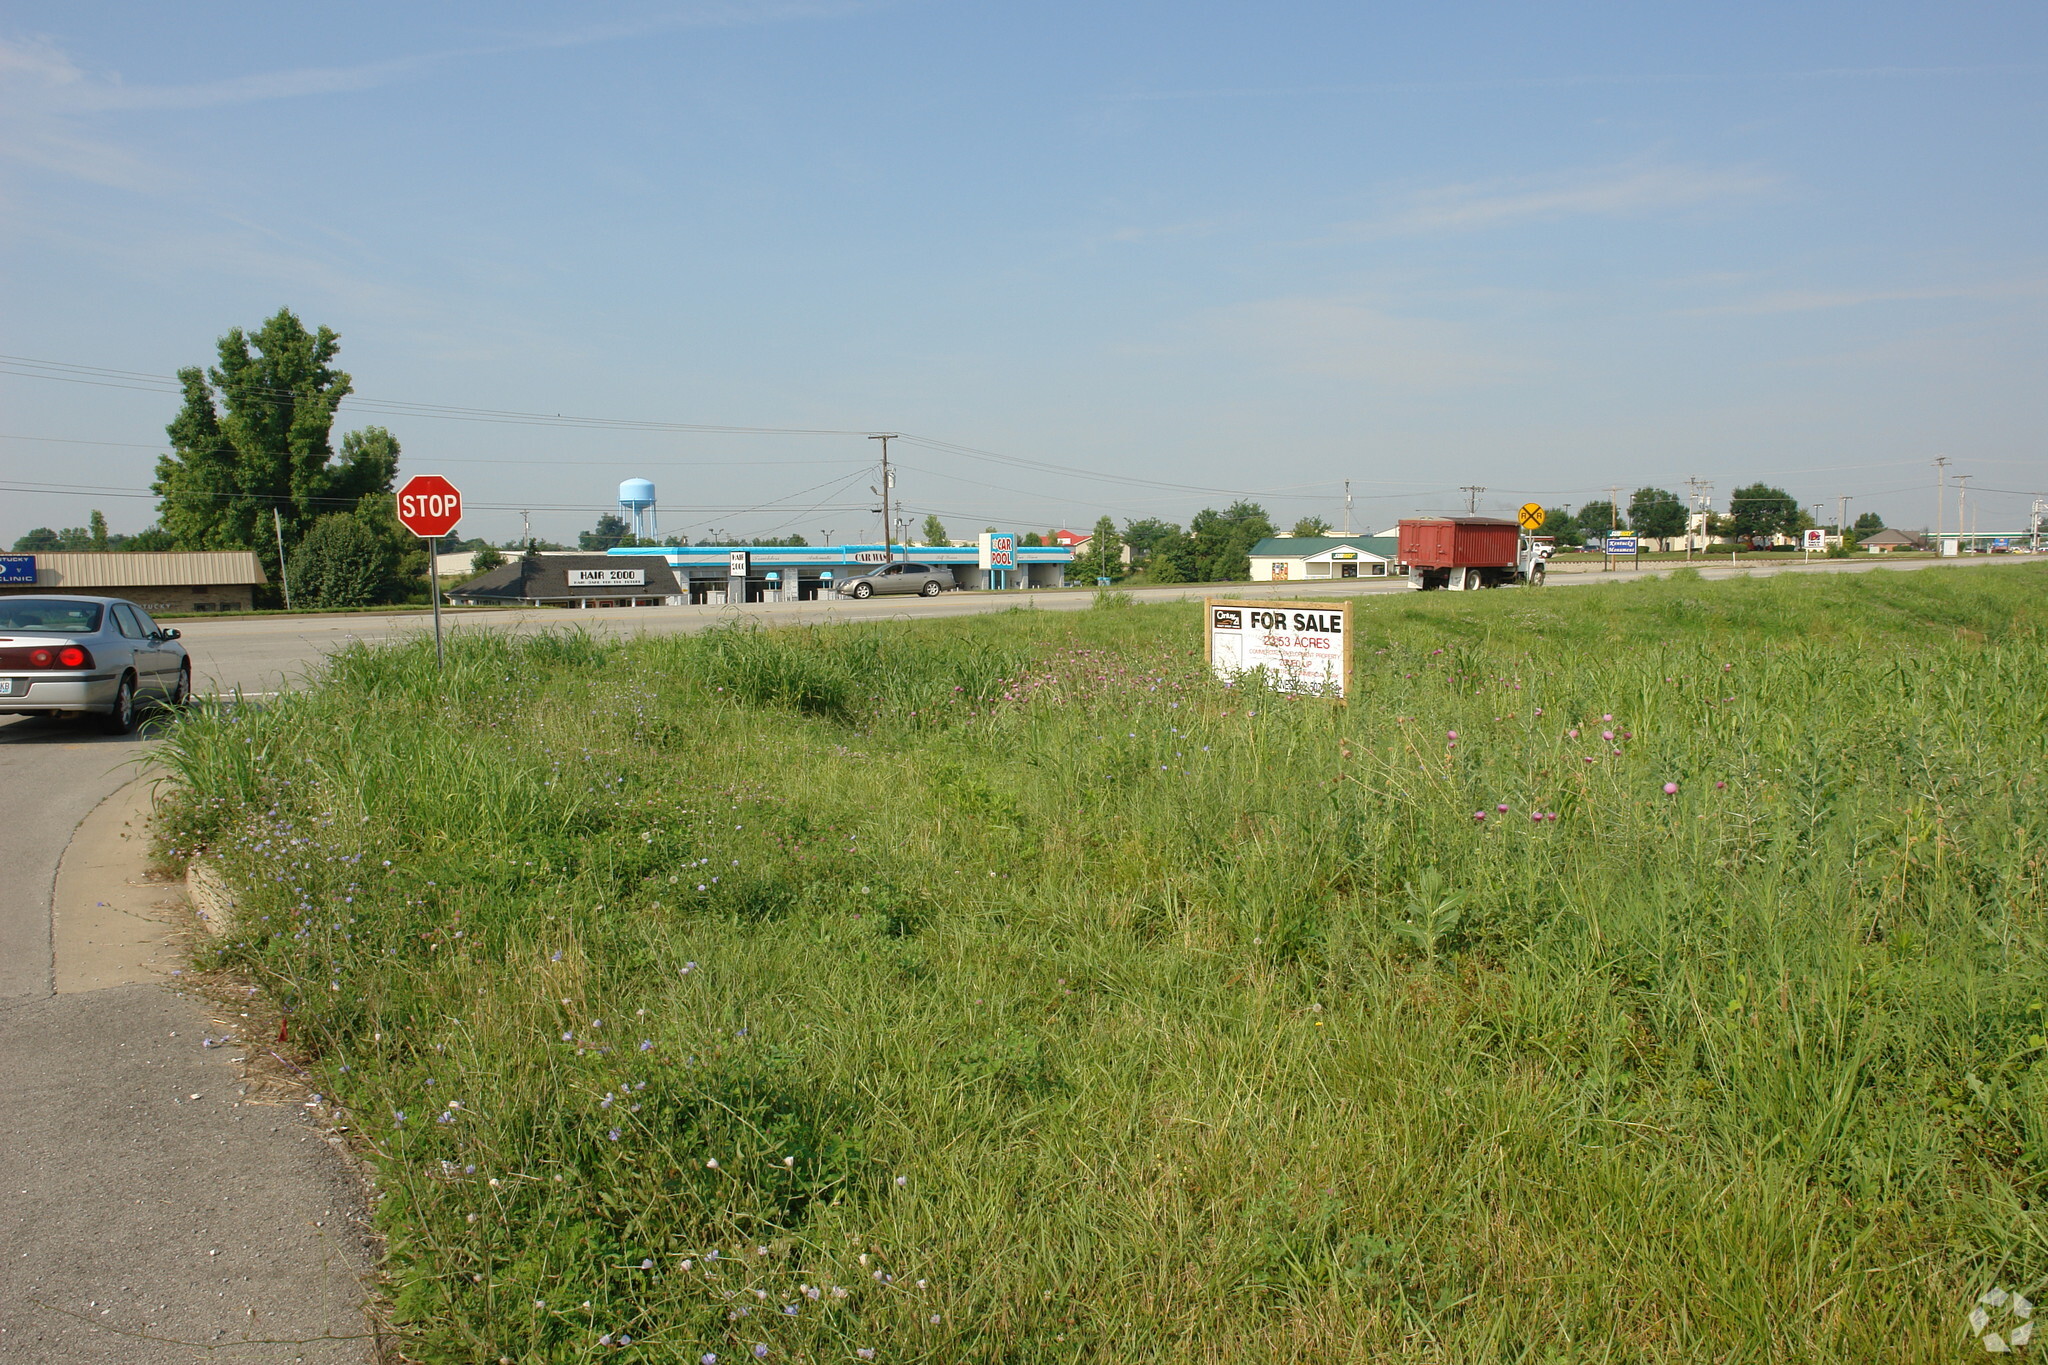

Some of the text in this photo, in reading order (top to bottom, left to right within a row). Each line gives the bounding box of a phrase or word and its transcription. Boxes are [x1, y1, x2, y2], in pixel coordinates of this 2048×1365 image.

[403, 494, 458, 518] STOP
[997, 538, 1012, 551] CAR
[855, 553, 871, 562] CAR
[992, 552, 1012, 565] POOL
[580, 571, 636, 580] HAIR 2000
[1251, 611, 1342, 634] FOR SALE
[1293, 636, 1331, 649] ACRES
